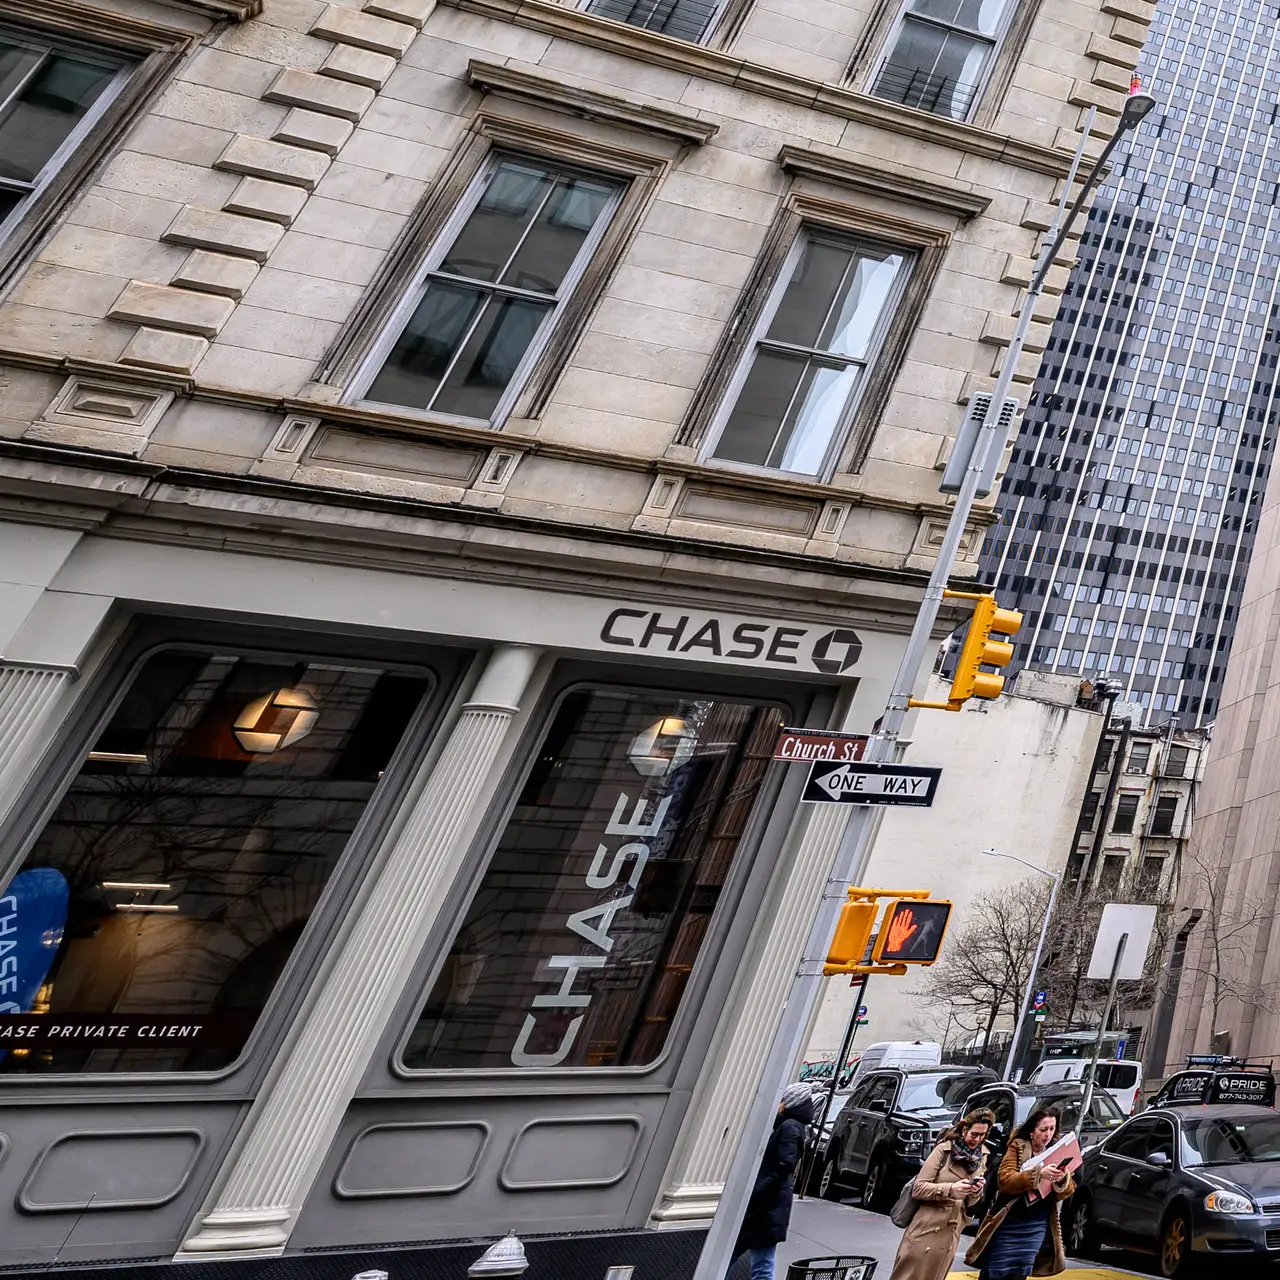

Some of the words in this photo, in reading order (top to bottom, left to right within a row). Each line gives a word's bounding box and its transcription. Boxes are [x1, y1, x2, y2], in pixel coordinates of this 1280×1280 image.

[600, 608, 808, 664] CHASE
[781, 737, 836, 759] Church
[840, 742, 859, 761] St
[828, 774, 867, 791] ONE
[883, 777, 923, 794] WAY
[510, 791, 674, 1067] CHASE
[0, 1025, 40, 1037] ASE
[47, 1025, 130, 1037] PRIVATE
[137, 1025, 203, 1037] CLIENT
[1182, 1077, 1208, 1092] PRIDE
[1230, 1080, 1267, 1090] PRIDE
